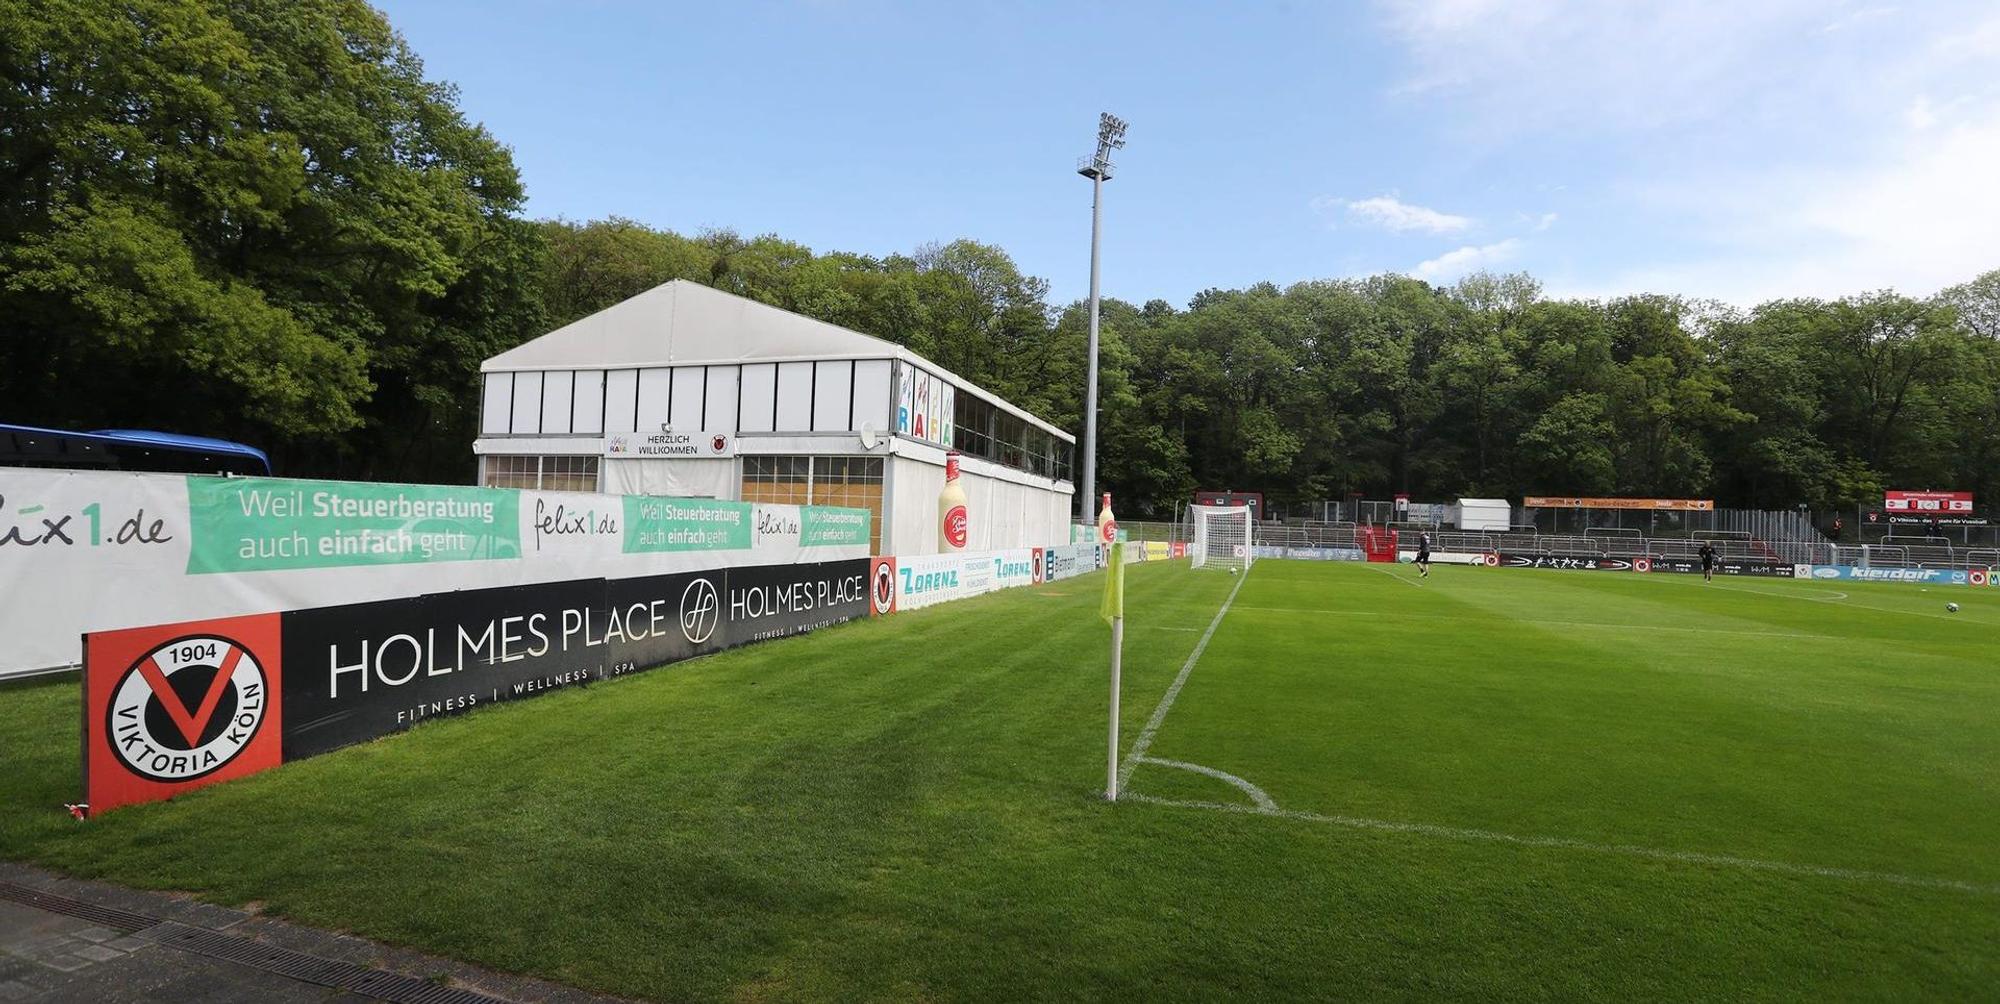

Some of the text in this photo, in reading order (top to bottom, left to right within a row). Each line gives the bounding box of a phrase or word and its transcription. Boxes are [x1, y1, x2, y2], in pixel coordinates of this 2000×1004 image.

[639, 446, 698, 455] WILLKOMMEN
[647, 435, 690, 444] HERZLICH
[238, 489, 495, 523] Weil Steuerberatung
[640, 503, 740, 526] Weil Steuerberatung
[240, 527, 466, 559] auch einfach geht
[640, 528, 664, 545] auch
[668, 527, 705, 544] einfach
[730, 581, 813, 621] HOLMES
[817, 575, 863, 609] PLACE
[754, 629, 784, 641] FITNESS
[168, 642, 217, 665] 1904
[330, 599, 666, 699] HOLMES PLACE
[397, 662, 635, 724] FITNESS WELLNESS SPA
[117, 682, 261, 774] VIKTORIA KÖLN
